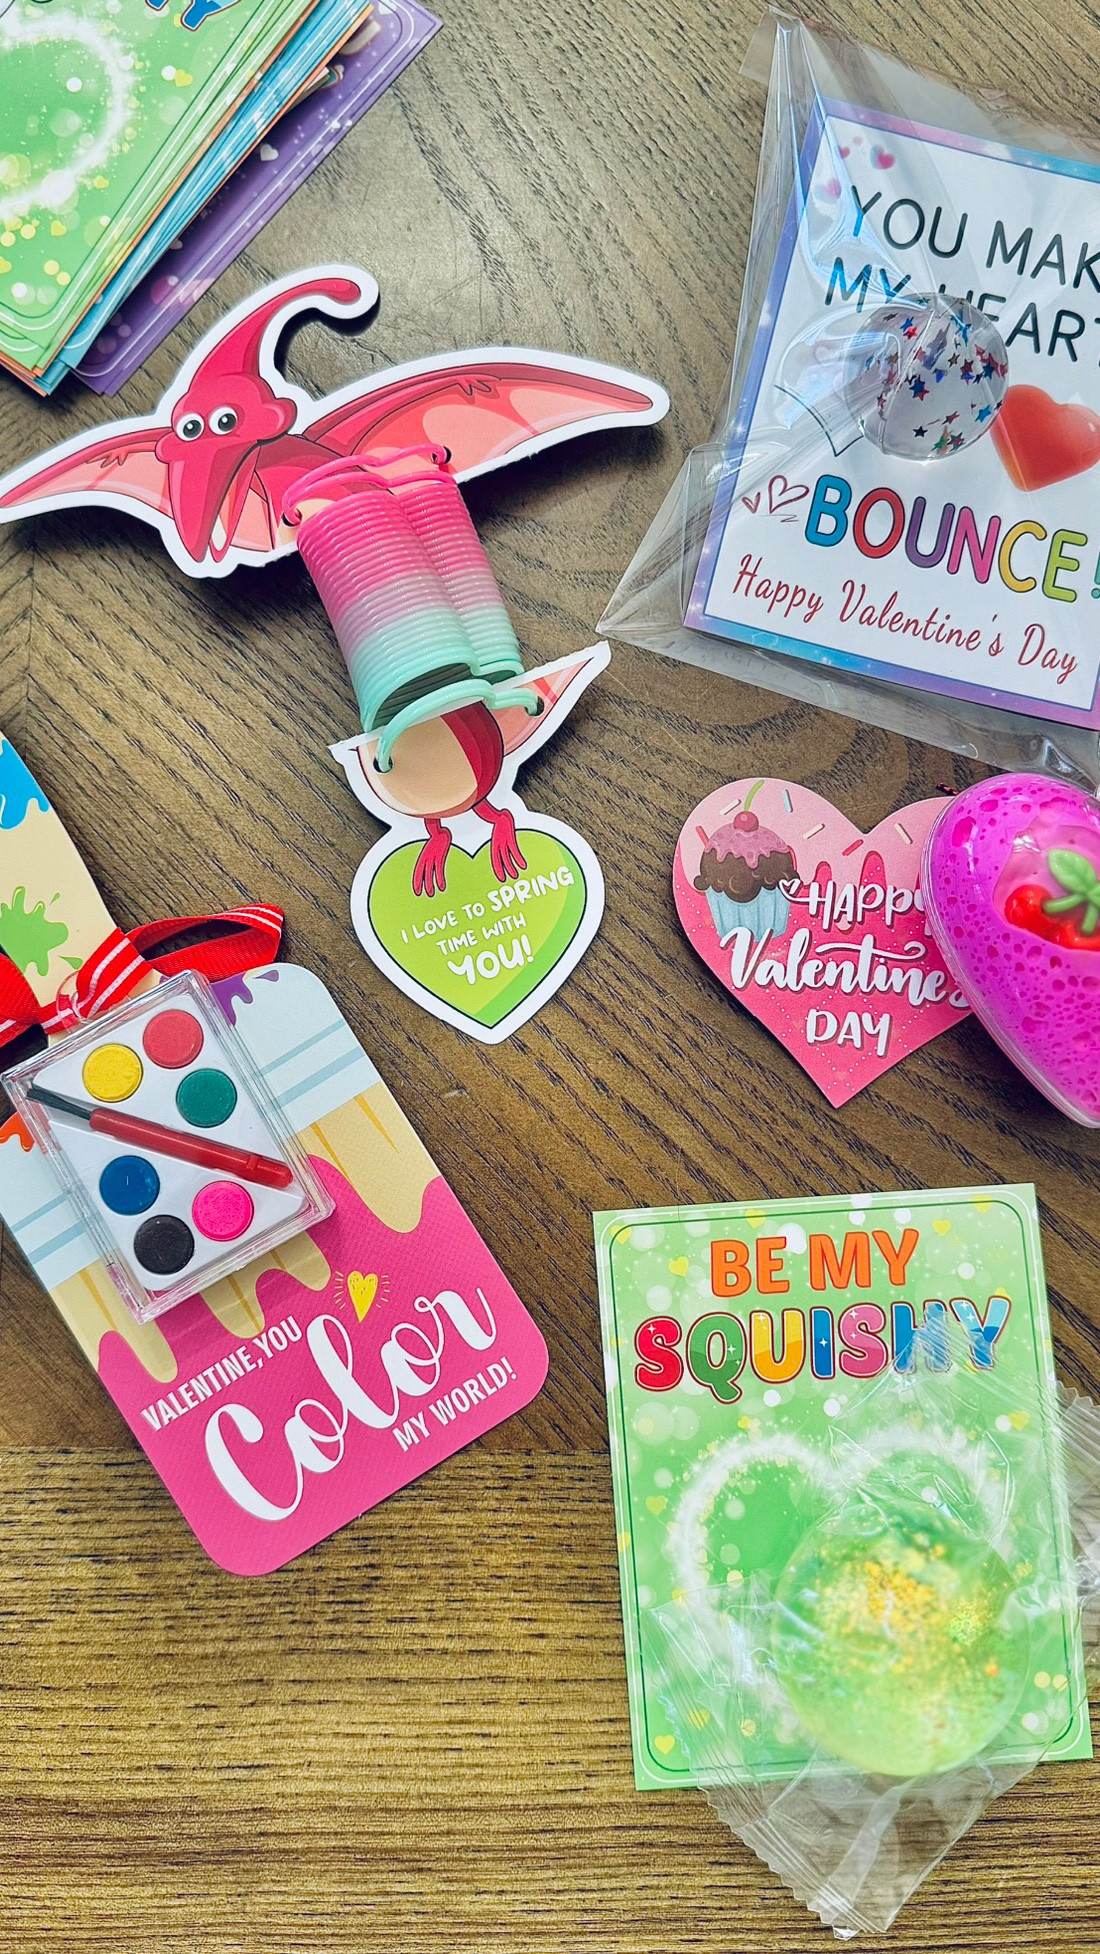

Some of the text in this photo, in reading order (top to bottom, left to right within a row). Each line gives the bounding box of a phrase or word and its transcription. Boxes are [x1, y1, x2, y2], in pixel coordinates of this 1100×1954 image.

[851, 185, 968, 258] YOU
[825, 257, 1100, 366] MY EAR
[732, 553, 1078, 685] Happy Valentine's Day
[400, 866, 575, 943] I LOVE TO SPRING
[436, 912, 527, 956] TIME WITH
[447, 934, 535, 985] YOU!
[806, 1009, 891, 1057] DAY
[710, 1228, 919, 1297] BE MY
[251, 1315, 302, 1359] YOU
[634, 1295, 1011, 1404] SQUISHY
[205, 1287, 497, 1521] Color
[391, 1356, 517, 1452] MY WORLD!
